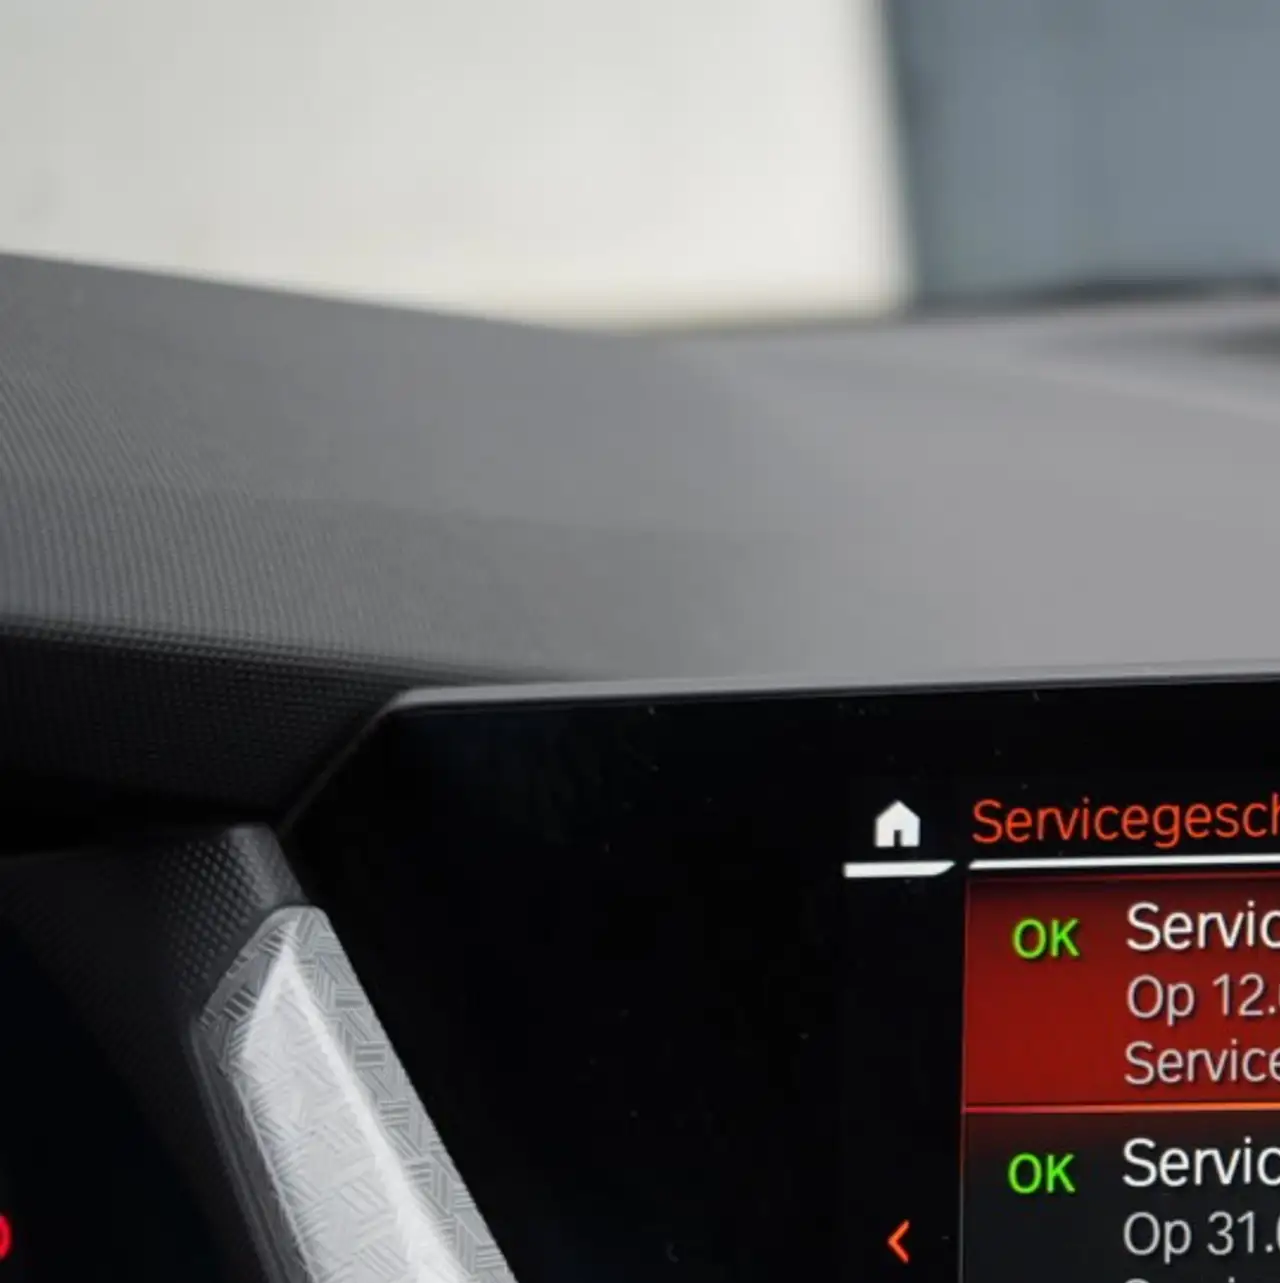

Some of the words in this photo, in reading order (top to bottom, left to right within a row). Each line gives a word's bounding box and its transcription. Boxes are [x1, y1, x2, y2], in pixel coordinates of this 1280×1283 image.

[1013, 919, 1079, 958] OK
[1128, 975, 1194, 1026] Op
[1008, 1153, 1075, 1193] OK
[1124, 1212, 1191, 1263] Op
